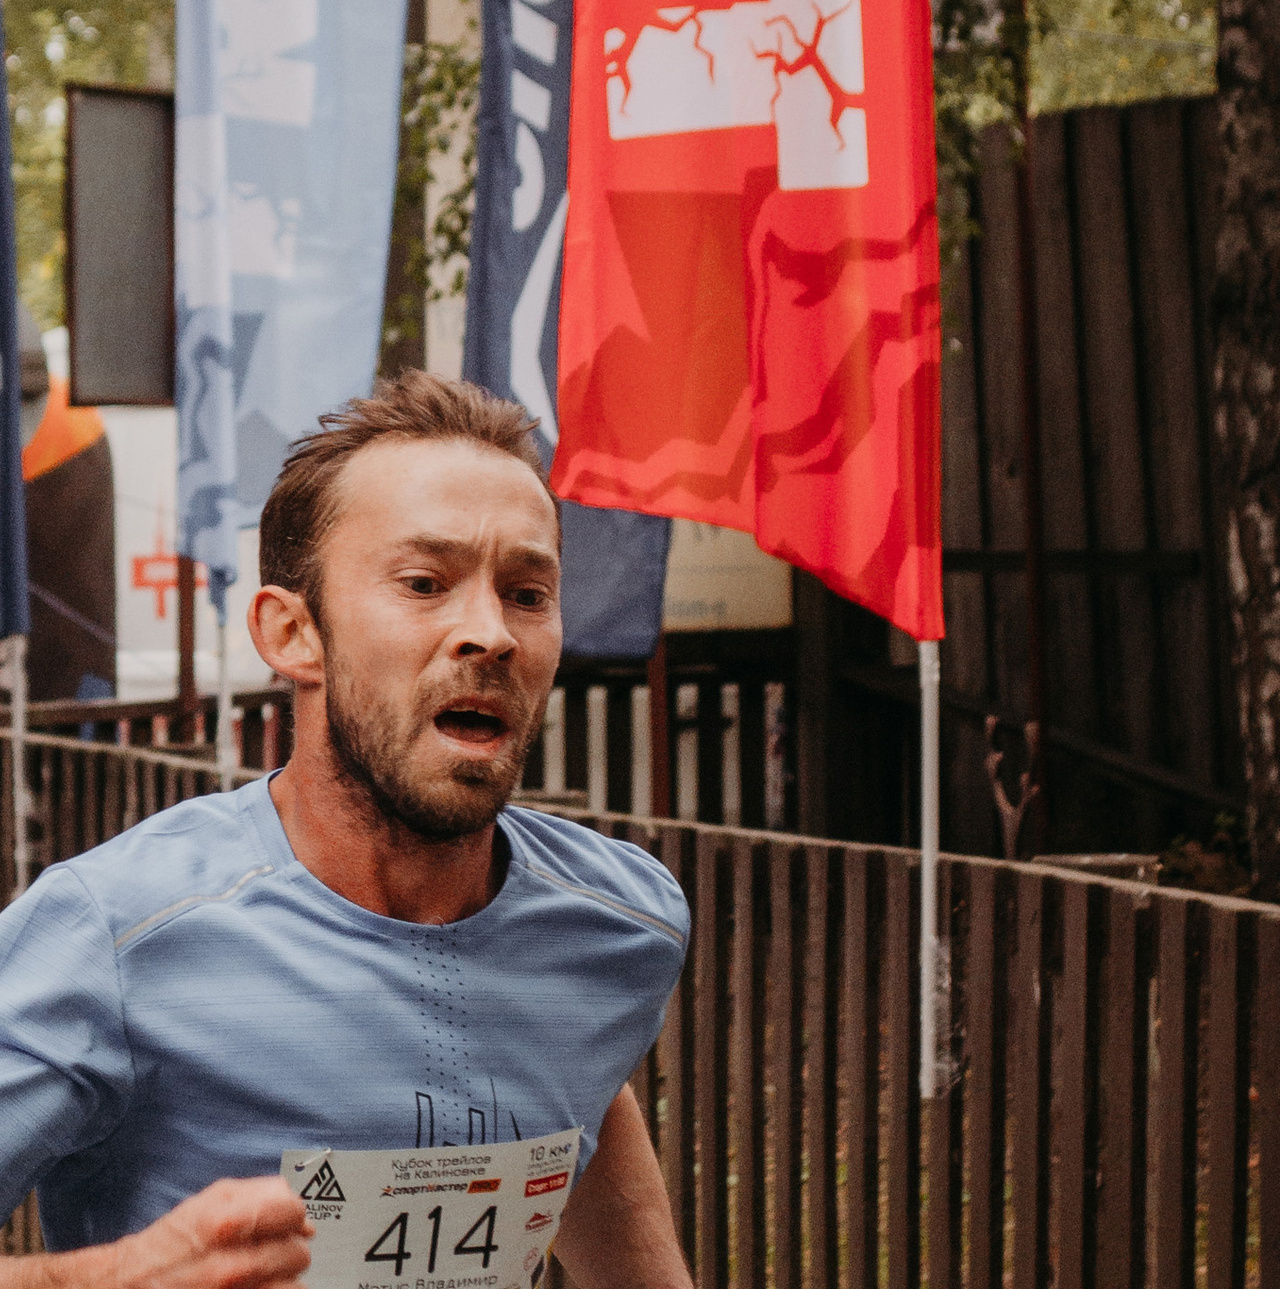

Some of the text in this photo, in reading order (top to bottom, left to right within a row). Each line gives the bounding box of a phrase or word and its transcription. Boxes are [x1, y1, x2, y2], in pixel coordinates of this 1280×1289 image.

[530, 1145, 545, 1161] 10
[391, 1155, 492, 1172] Кубок трейлов
[394, 1166, 487, 1181] на Калиновке
[305, 1203, 344, 1213] ALINOV
[364, 1205, 499, 1276] 414
